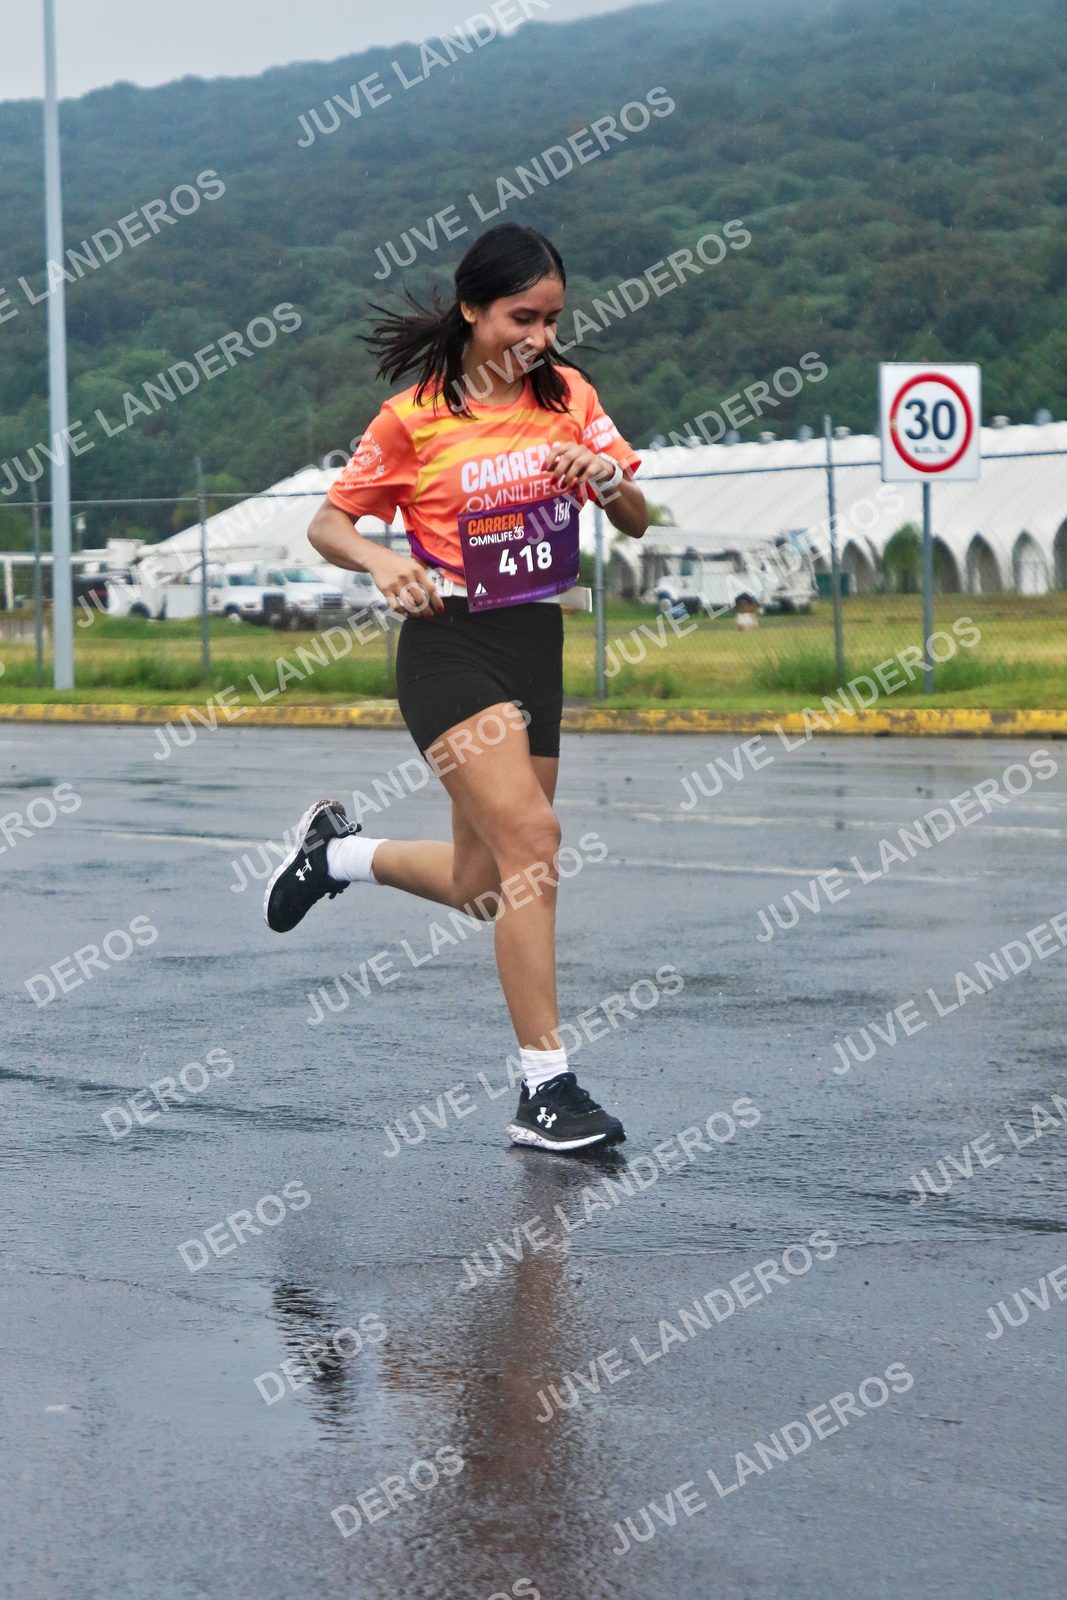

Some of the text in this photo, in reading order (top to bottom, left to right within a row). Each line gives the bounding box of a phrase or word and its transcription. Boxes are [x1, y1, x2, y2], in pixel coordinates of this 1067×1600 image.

[904, 399, 957, 440] 30
[461, 442, 560, 493] CARRE
[466, 478, 551, 512] OMNILIFE
[468, 512, 524, 536] CARRERA
[554, 502, 571, 523] 15K
[499, 541, 553, 576] 418
